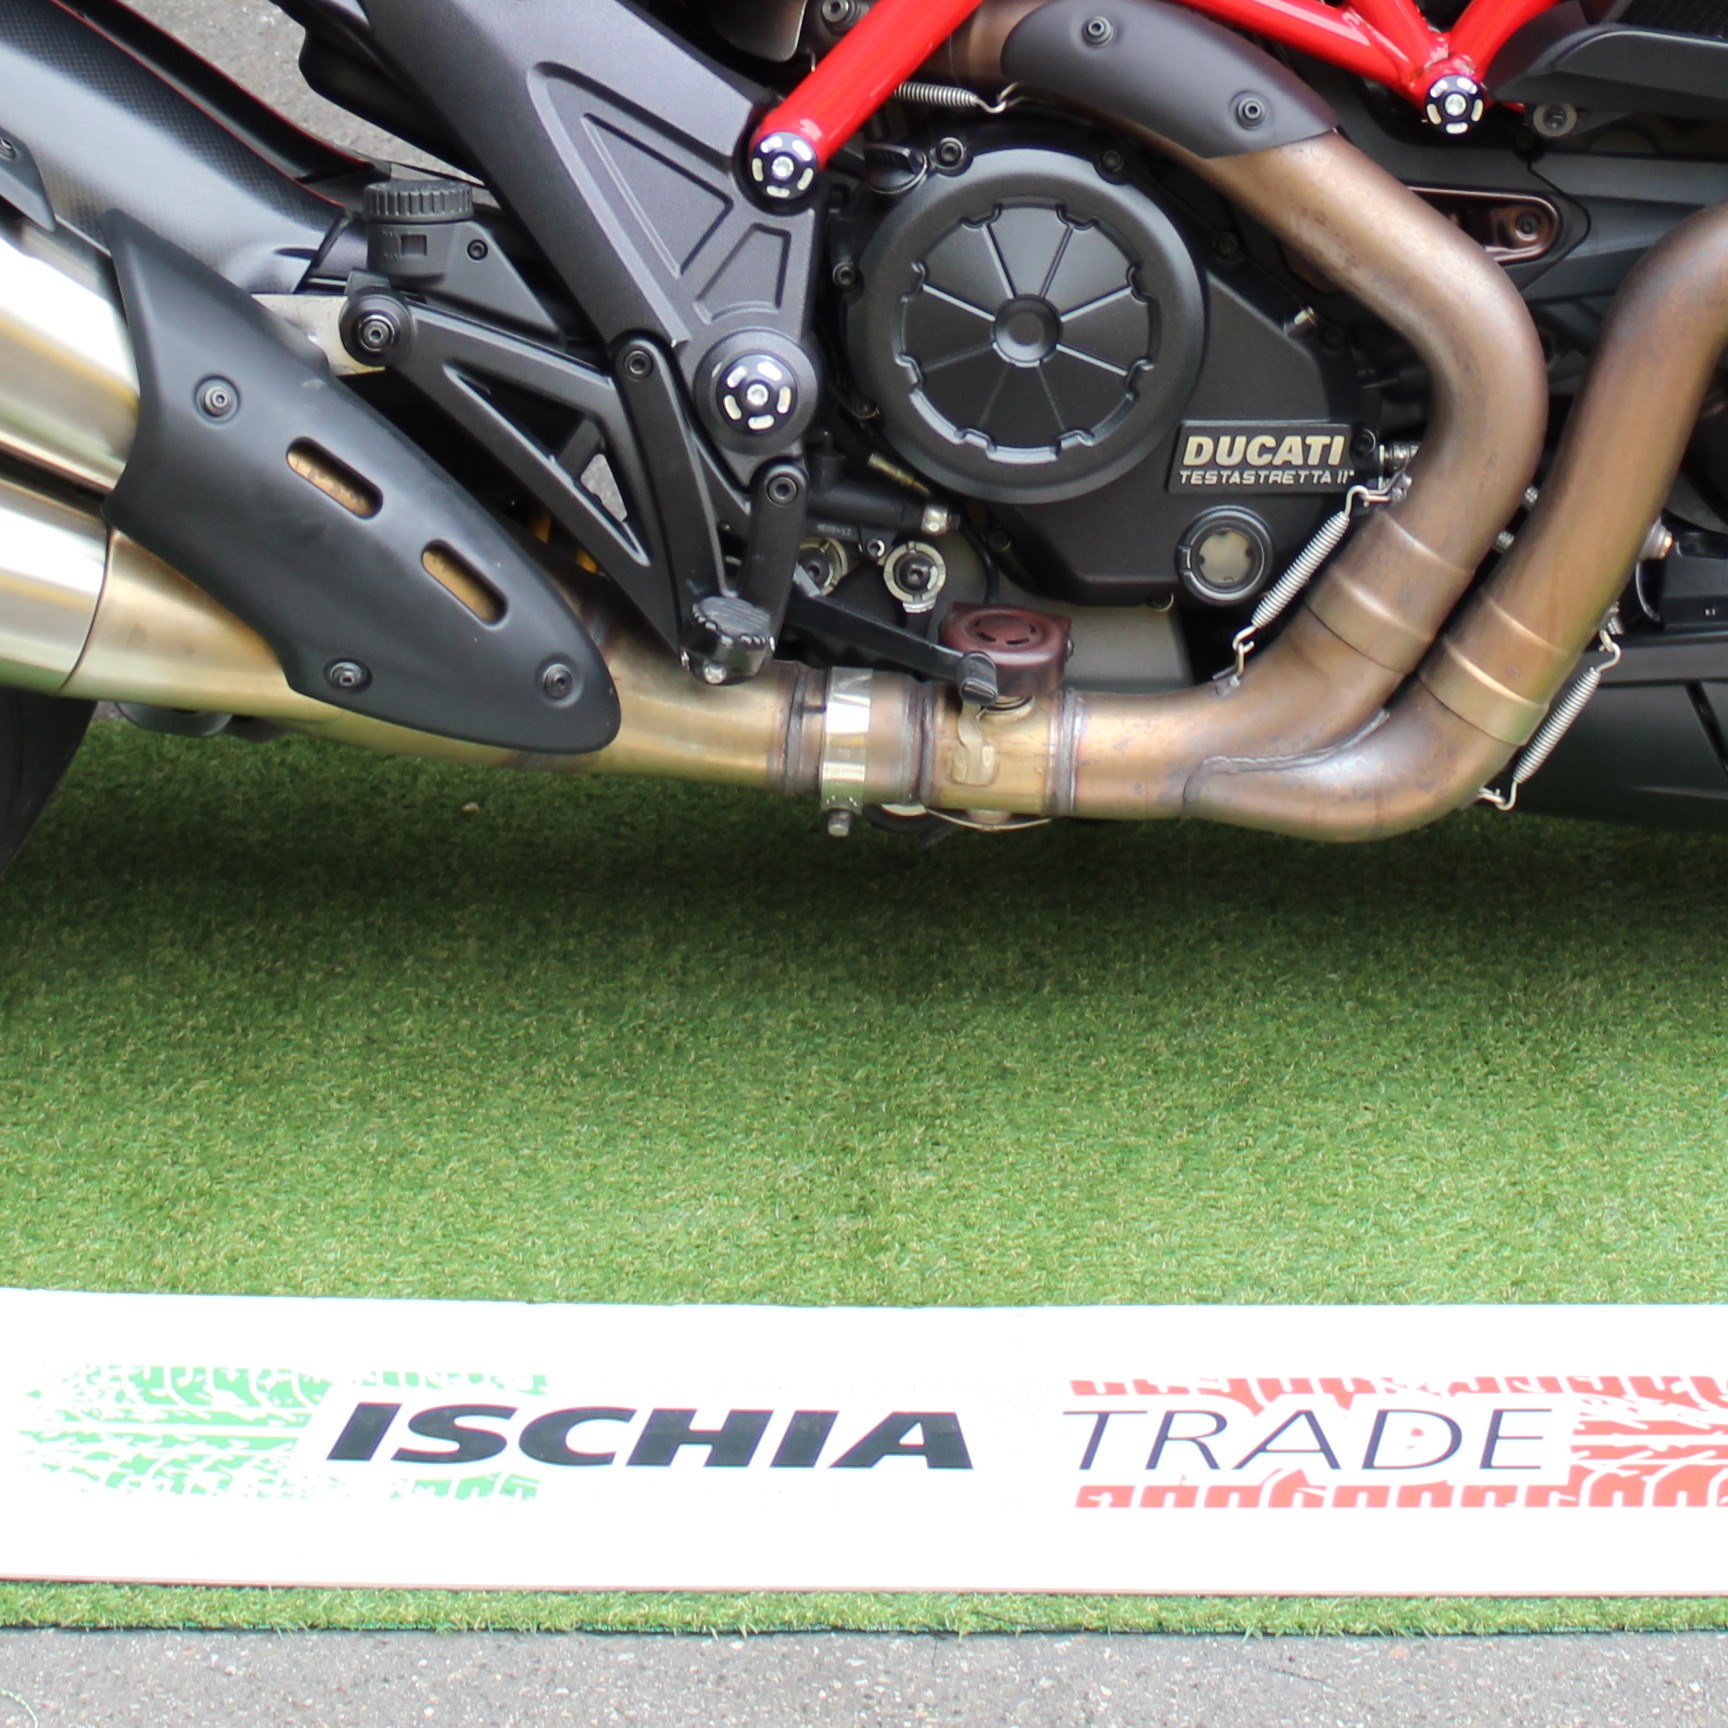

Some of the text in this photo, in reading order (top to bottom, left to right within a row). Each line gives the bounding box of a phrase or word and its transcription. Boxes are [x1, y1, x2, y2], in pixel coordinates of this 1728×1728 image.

[1182, 435, 1345, 467] DUCATI
[1178, 470, 1331, 485] TESTASTRETTA
[328, 1404, 1554, 1471] ISCHIA TRADE
